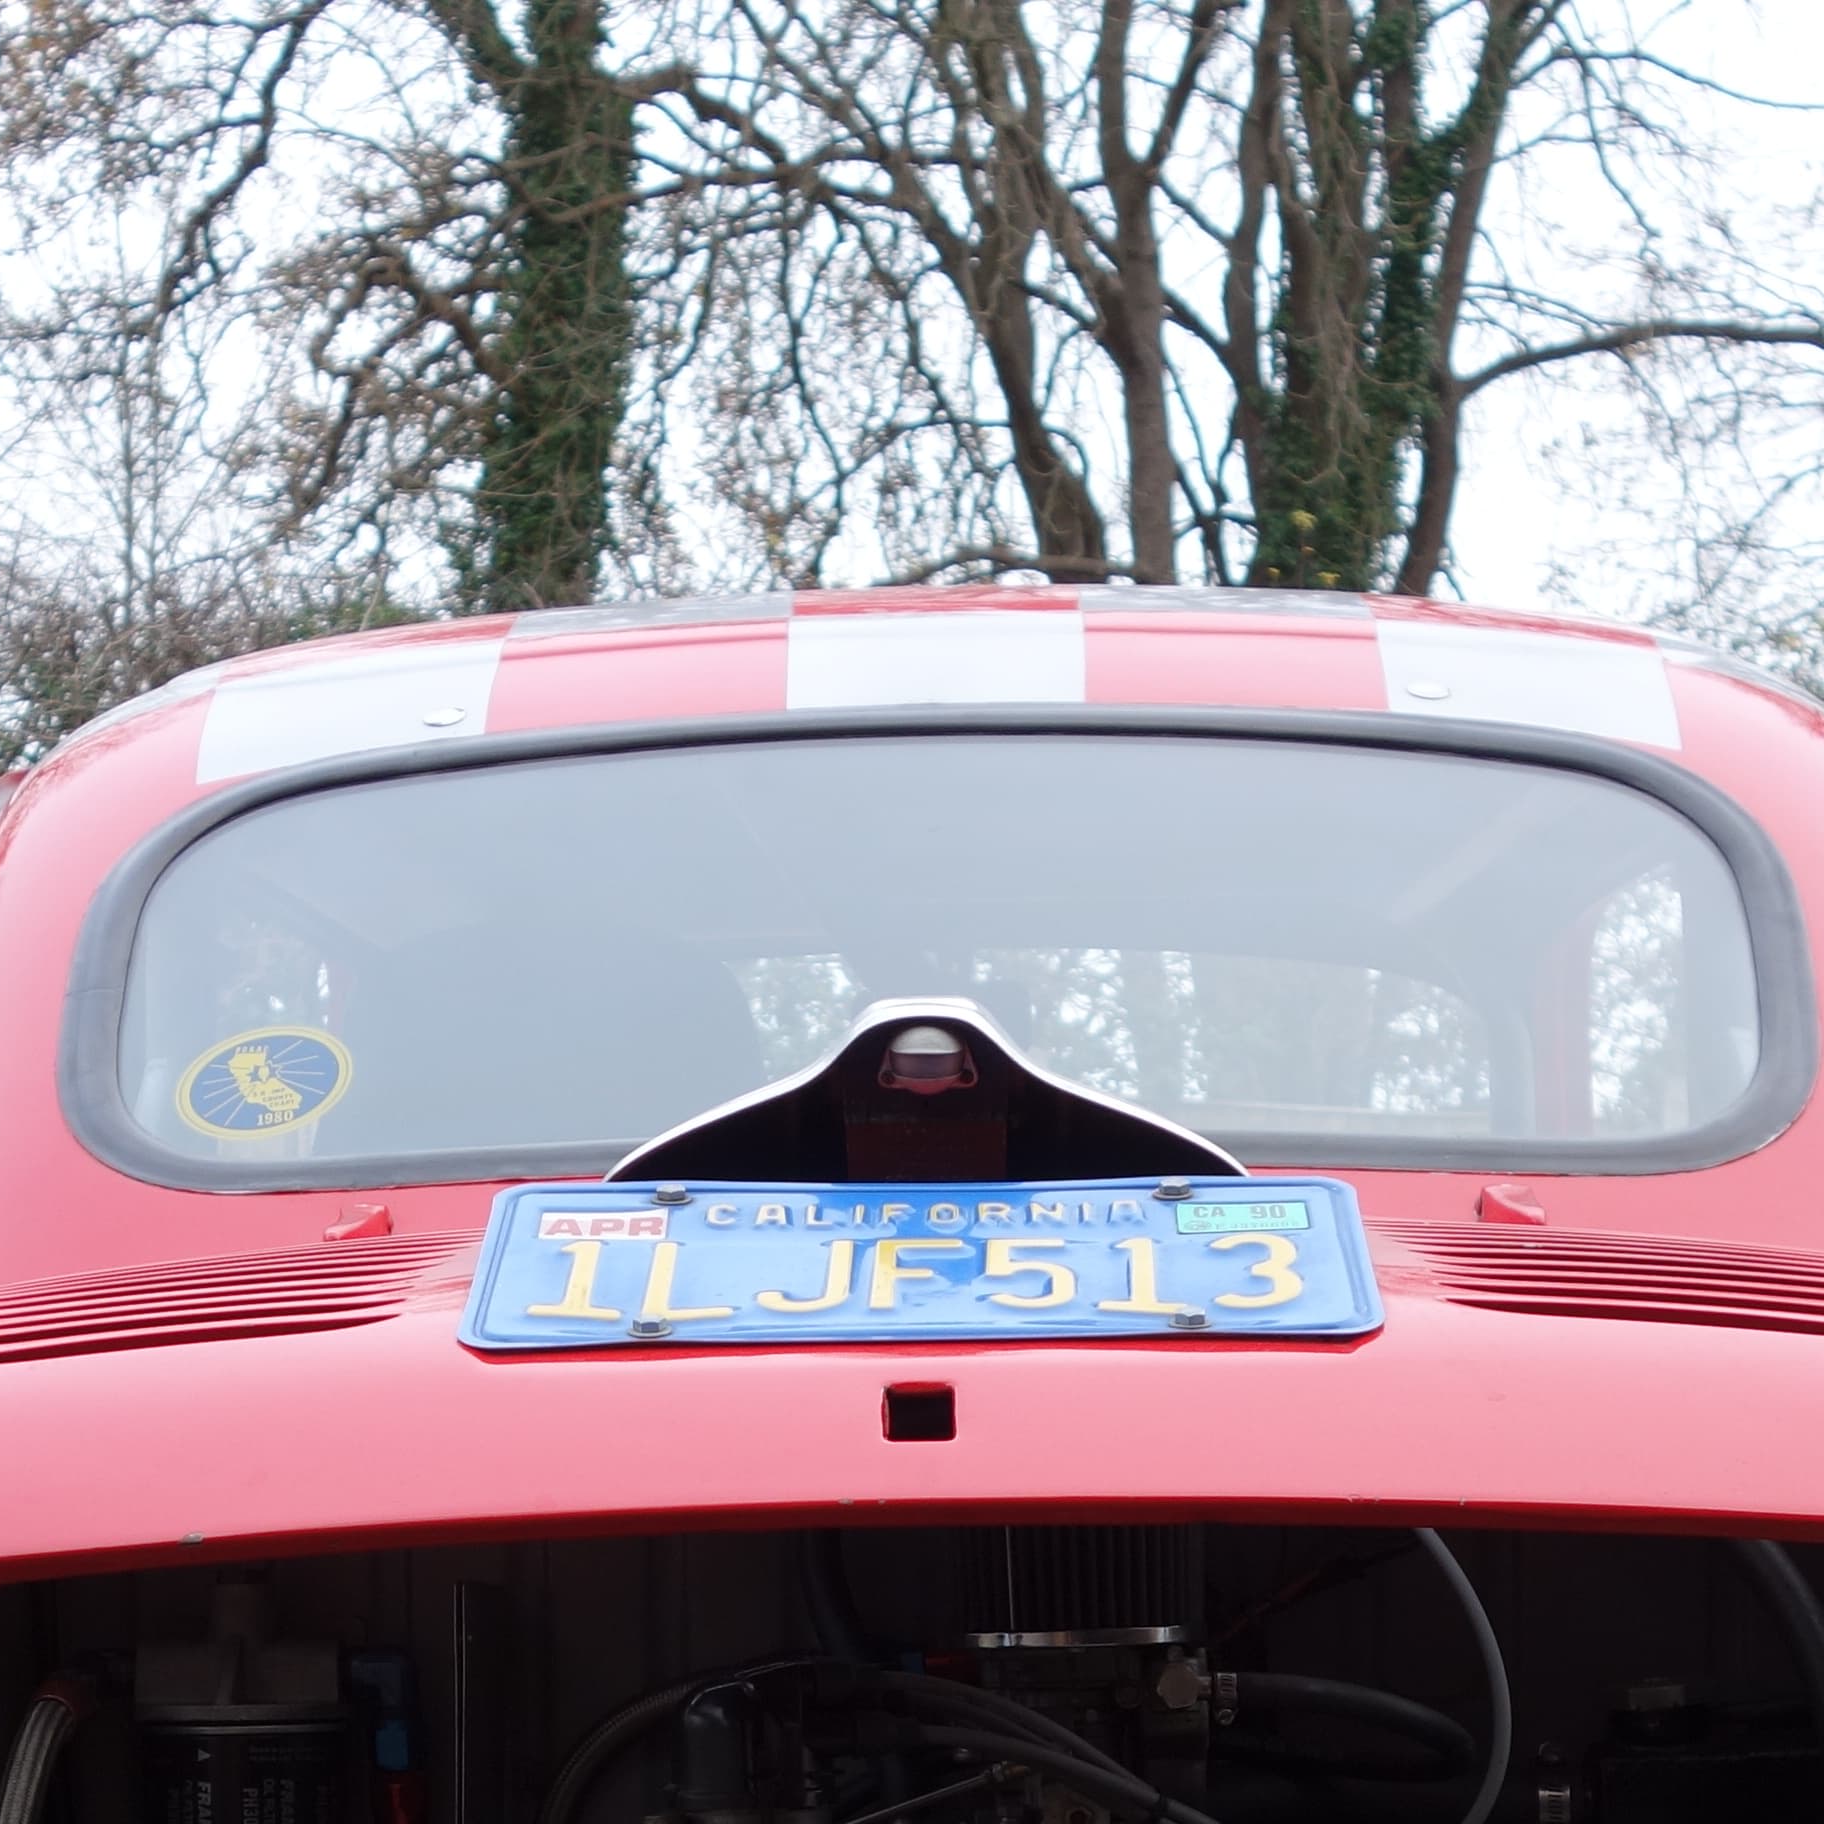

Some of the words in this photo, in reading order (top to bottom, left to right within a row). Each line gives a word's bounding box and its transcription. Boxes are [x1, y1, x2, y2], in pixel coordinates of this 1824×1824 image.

[256, 1110, 293, 1126] 1980
[705, 1200, 1148, 1228] CALIFORNIA
[1192, 1206, 1226, 1218] CA
[1248, 1204, 1287, 1219] 90
[543, 1216, 664, 1236] APR
